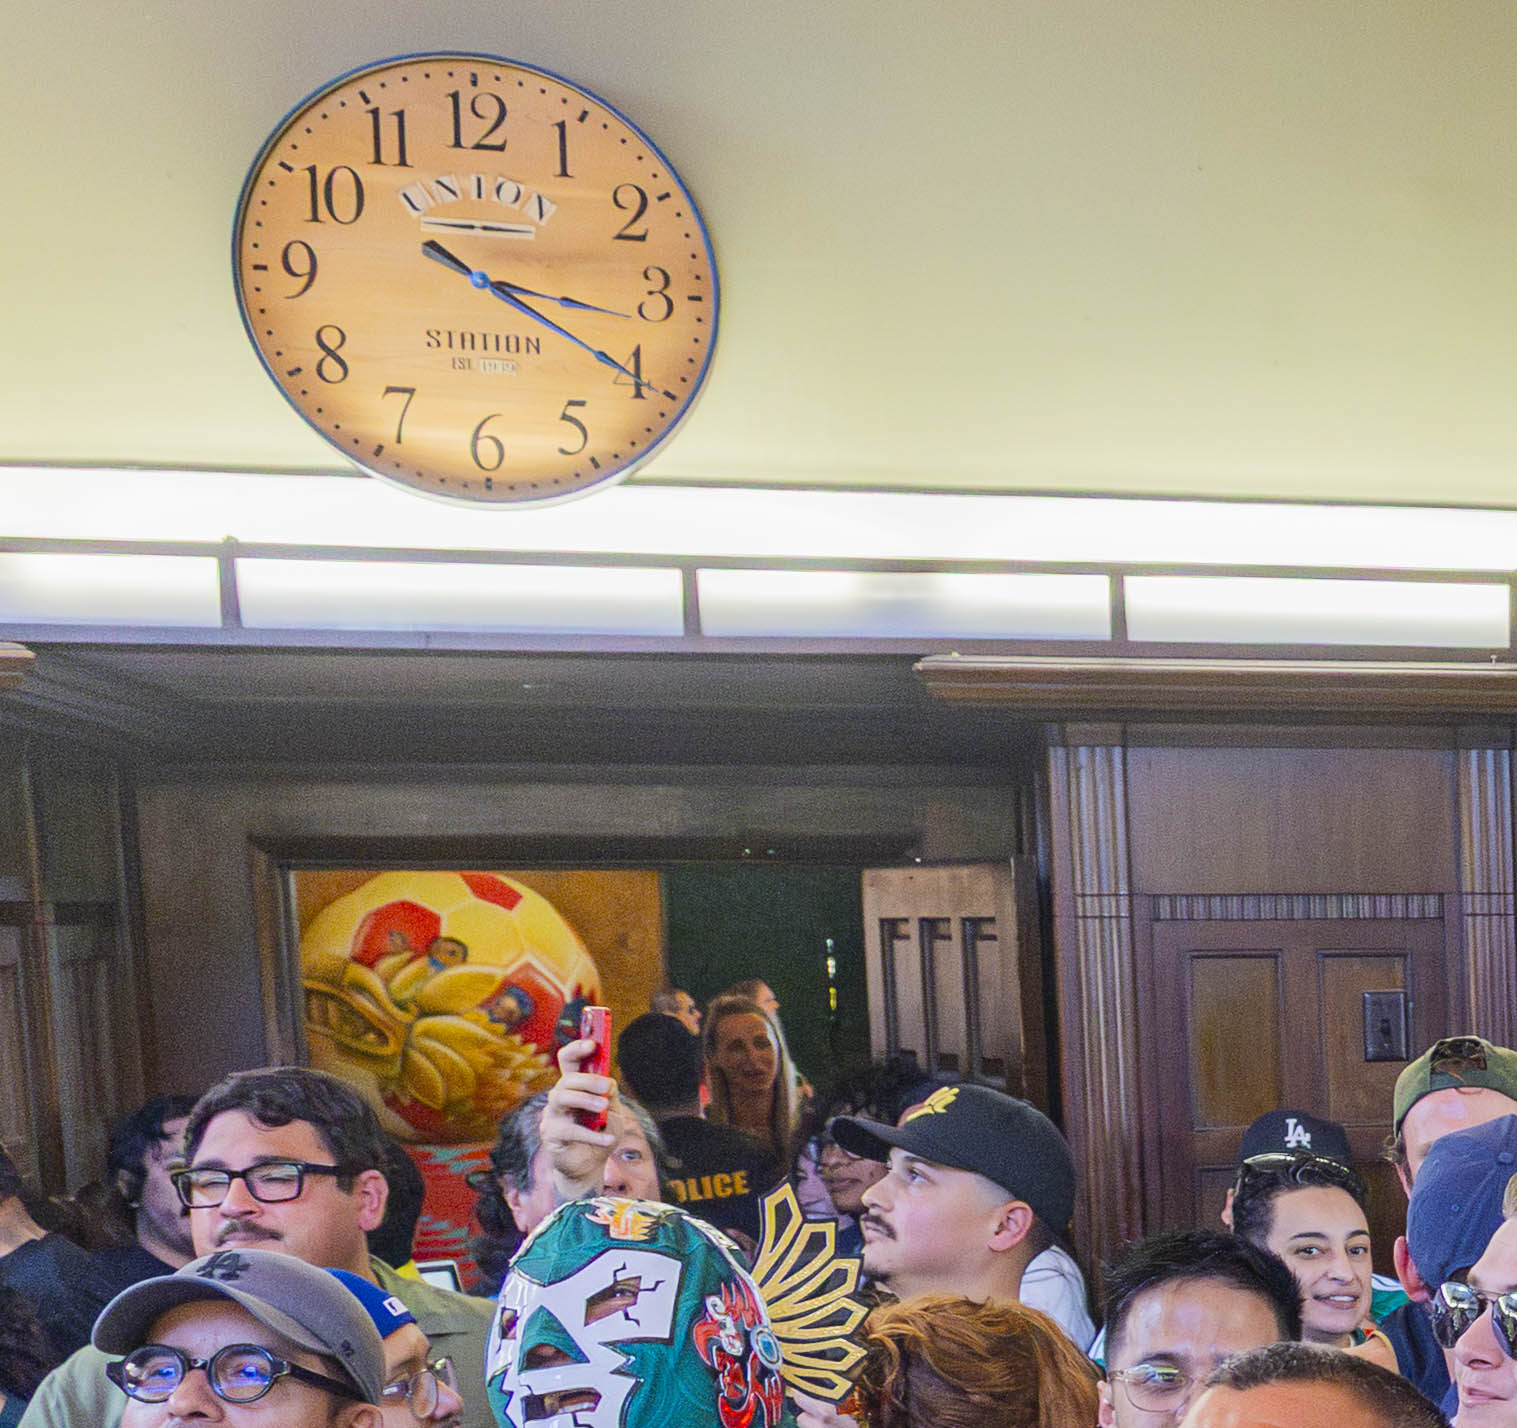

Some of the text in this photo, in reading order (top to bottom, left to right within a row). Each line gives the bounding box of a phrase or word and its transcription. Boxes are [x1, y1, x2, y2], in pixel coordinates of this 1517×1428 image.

[364, 106, 415, 168] 11
[446, 89, 509, 152] 12
[551, 119, 575, 179] 1
[303, 164, 365, 225] 10
[402, 175, 552, 221] UNION
[612, 183, 650, 243] 2
[281, 239, 318, 300] 9
[637, 265, 675, 323] 3
[315, 324, 349, 385] 8
[426, 329, 541, 355] STATION
[612, 343, 651, 400] 4
[382, 386, 416, 445] 7
[471, 414, 505, 472] 6
[557, 400, 589, 457] 5
[1284, 1118, 1312, 1149] LA
